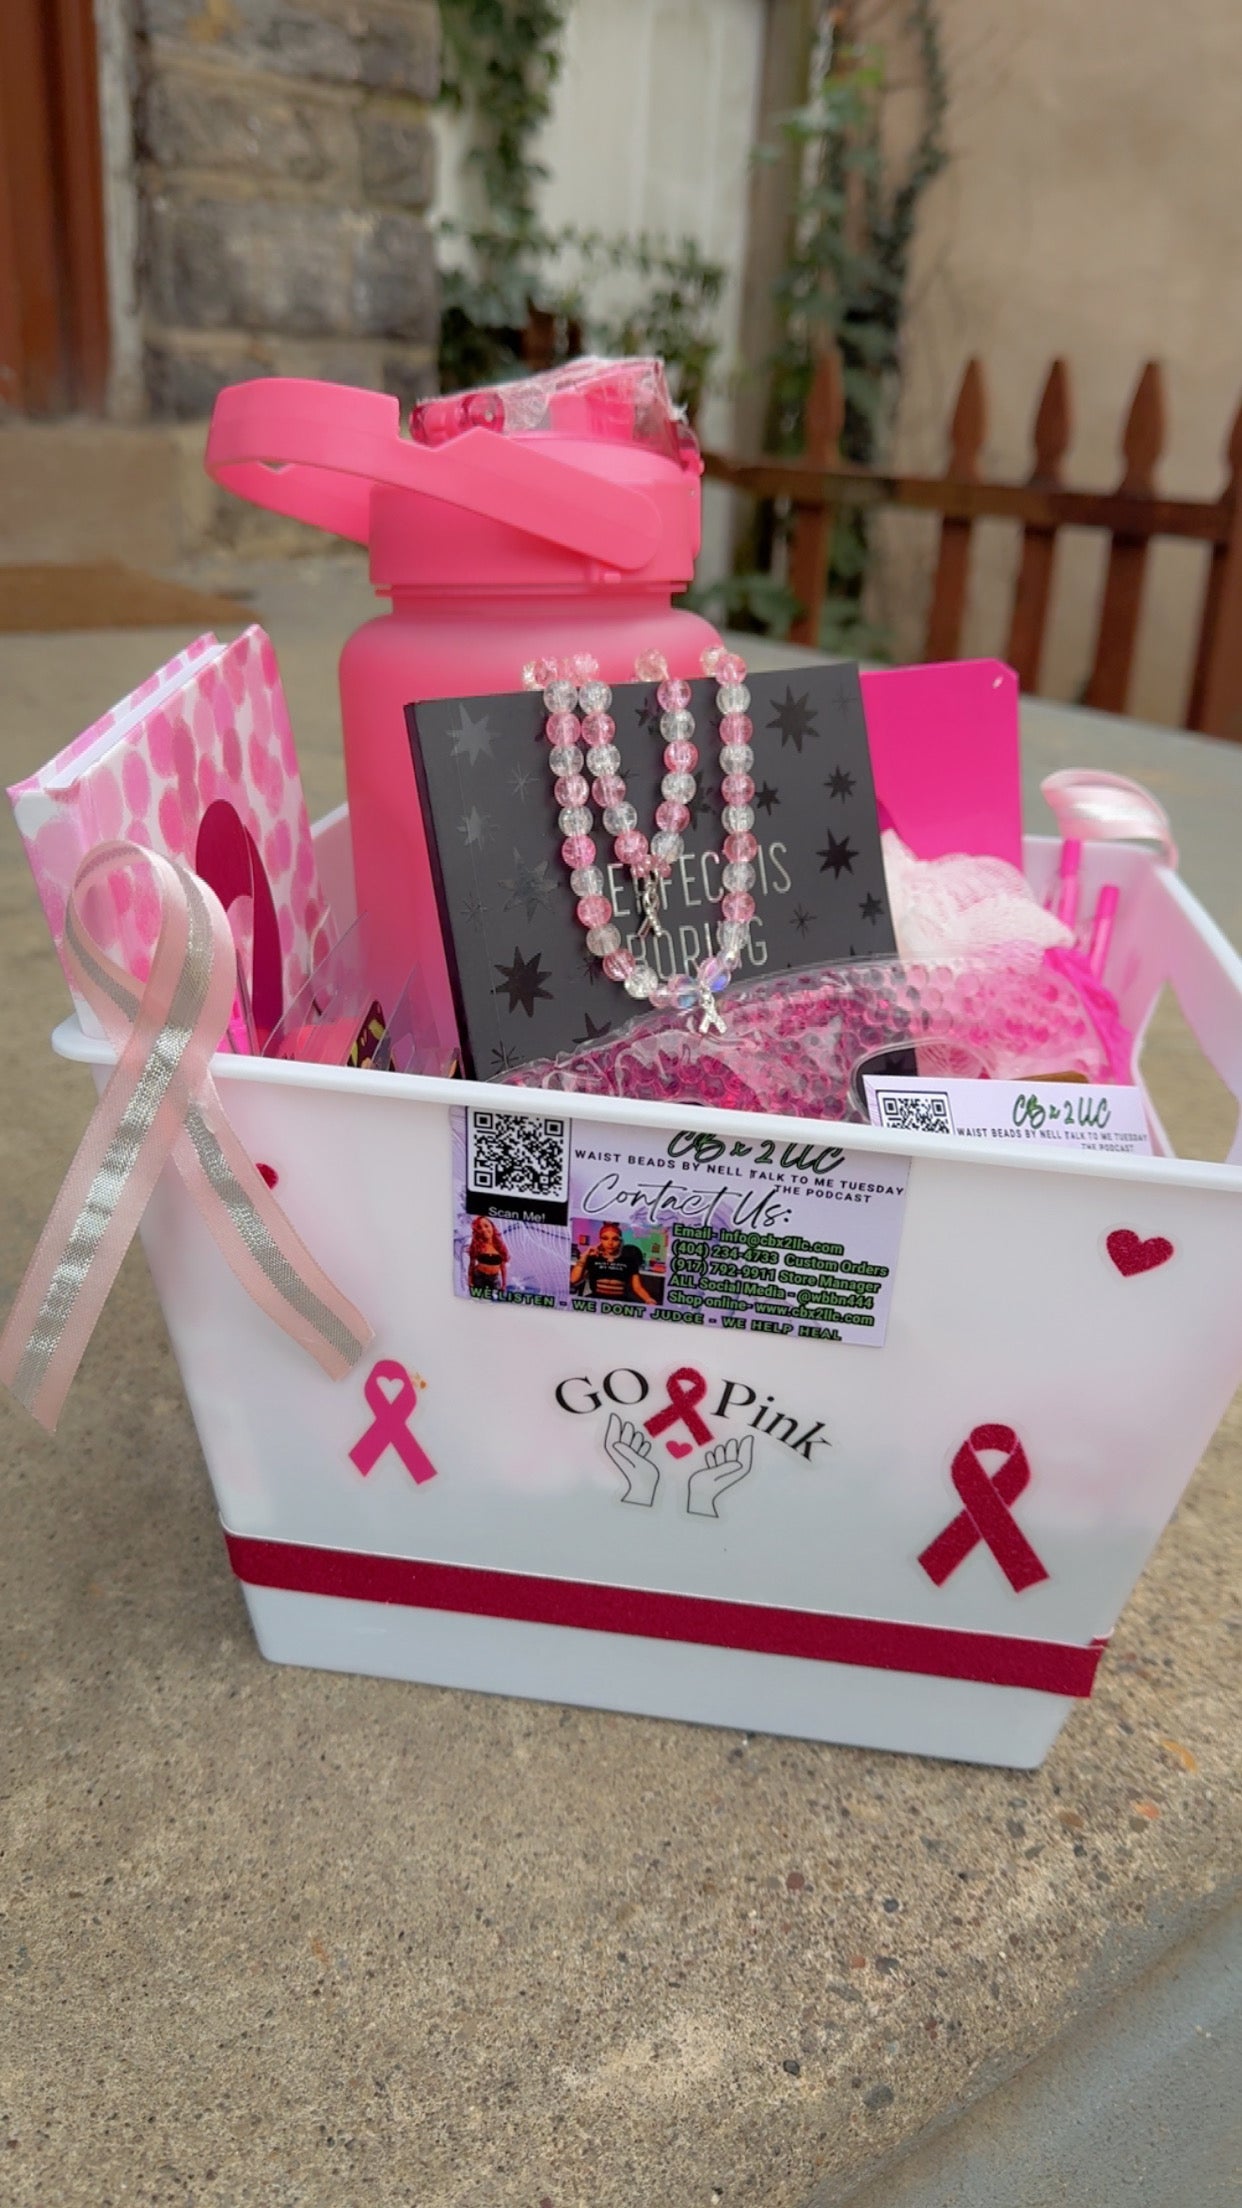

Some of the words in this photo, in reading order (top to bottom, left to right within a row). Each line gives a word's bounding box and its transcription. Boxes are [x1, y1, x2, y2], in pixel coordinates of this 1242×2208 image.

[607, 850, 724, 917] EFEC
[757, 842, 792, 896] IS
[626, 916, 769, 980] BORIG
[1064, 1100, 1075, 1124] 2
[755, 1140, 776, 1164] 2
[957, 1127, 988, 1138] WAIST
[991, 1128, 1022, 1139] BEADS
[1025, 1128, 1036, 1139] BY
[1040, 1129, 1062, 1140] NELL
[1065, 1131, 1085, 1141] TALK
[1087, 1132, 1099, 1141] TO
[1101, 1132, 1113, 1141] ME
[1115, 1132, 1148, 1142] TUESDAY
[575, 1149, 622, 1163] WAIST
[628, 1156, 676, 1170] BEADS
[682, 1161, 701, 1171] BY
[706, 1164, 743, 1177] NELL
[791, 1174, 808, 1184] TO
[814, 1176, 834, 1188] ME
[841, 1180, 904, 1196] TUESDAY
[583, 1172, 743, 1227] Contact
[733, 1187, 793, 1229] Us:
[774, 1184, 800, 1196] THE
[806, 1187, 872, 1203] PODCAST
[488, 1206, 520, 1220] Scan
[523, 1210, 546, 1223] Me!
[671, 1239, 710, 1257] (404)
[712, 1245, 779, 1264] 234-4733
[784, 1253, 839, 1272] Custom
[840, 1261, 890, 1278] Orders
[720, 1230, 844, 1256] info@cbx2llc.com
[669, 1274, 697, 1289] ALL
[700, 1279, 740, 1294] Social
[743, 1284, 786, 1299] Media
[797, 1289, 874, 1309] @wbbn444
[670, 1257, 708, 1275] (917)
[710, 1262, 776, 1281] 792-9911
[778, 1270, 817, 1286] Store
[818, 1275, 881, 1295] Manager
[470, 1286, 494, 1300] WE
[498, 1292, 555, 1308] LISTEN
[571, 1298, 597, 1313] WE
[601, 1302, 647, 1318] DONT
[650, 1307, 705, 1325] JUDGE
[721, 1315, 747, 1329] WE
[750, 1319, 794, 1337] HELP
[798, 1324, 842, 1342] HEAL
[668, 1291, 704, 1309] Shop
[755, 1302, 875, 1326] www.cbx2llc.com
[555, 1367, 650, 1415] GO
[710, 1379, 833, 1462] Pink
